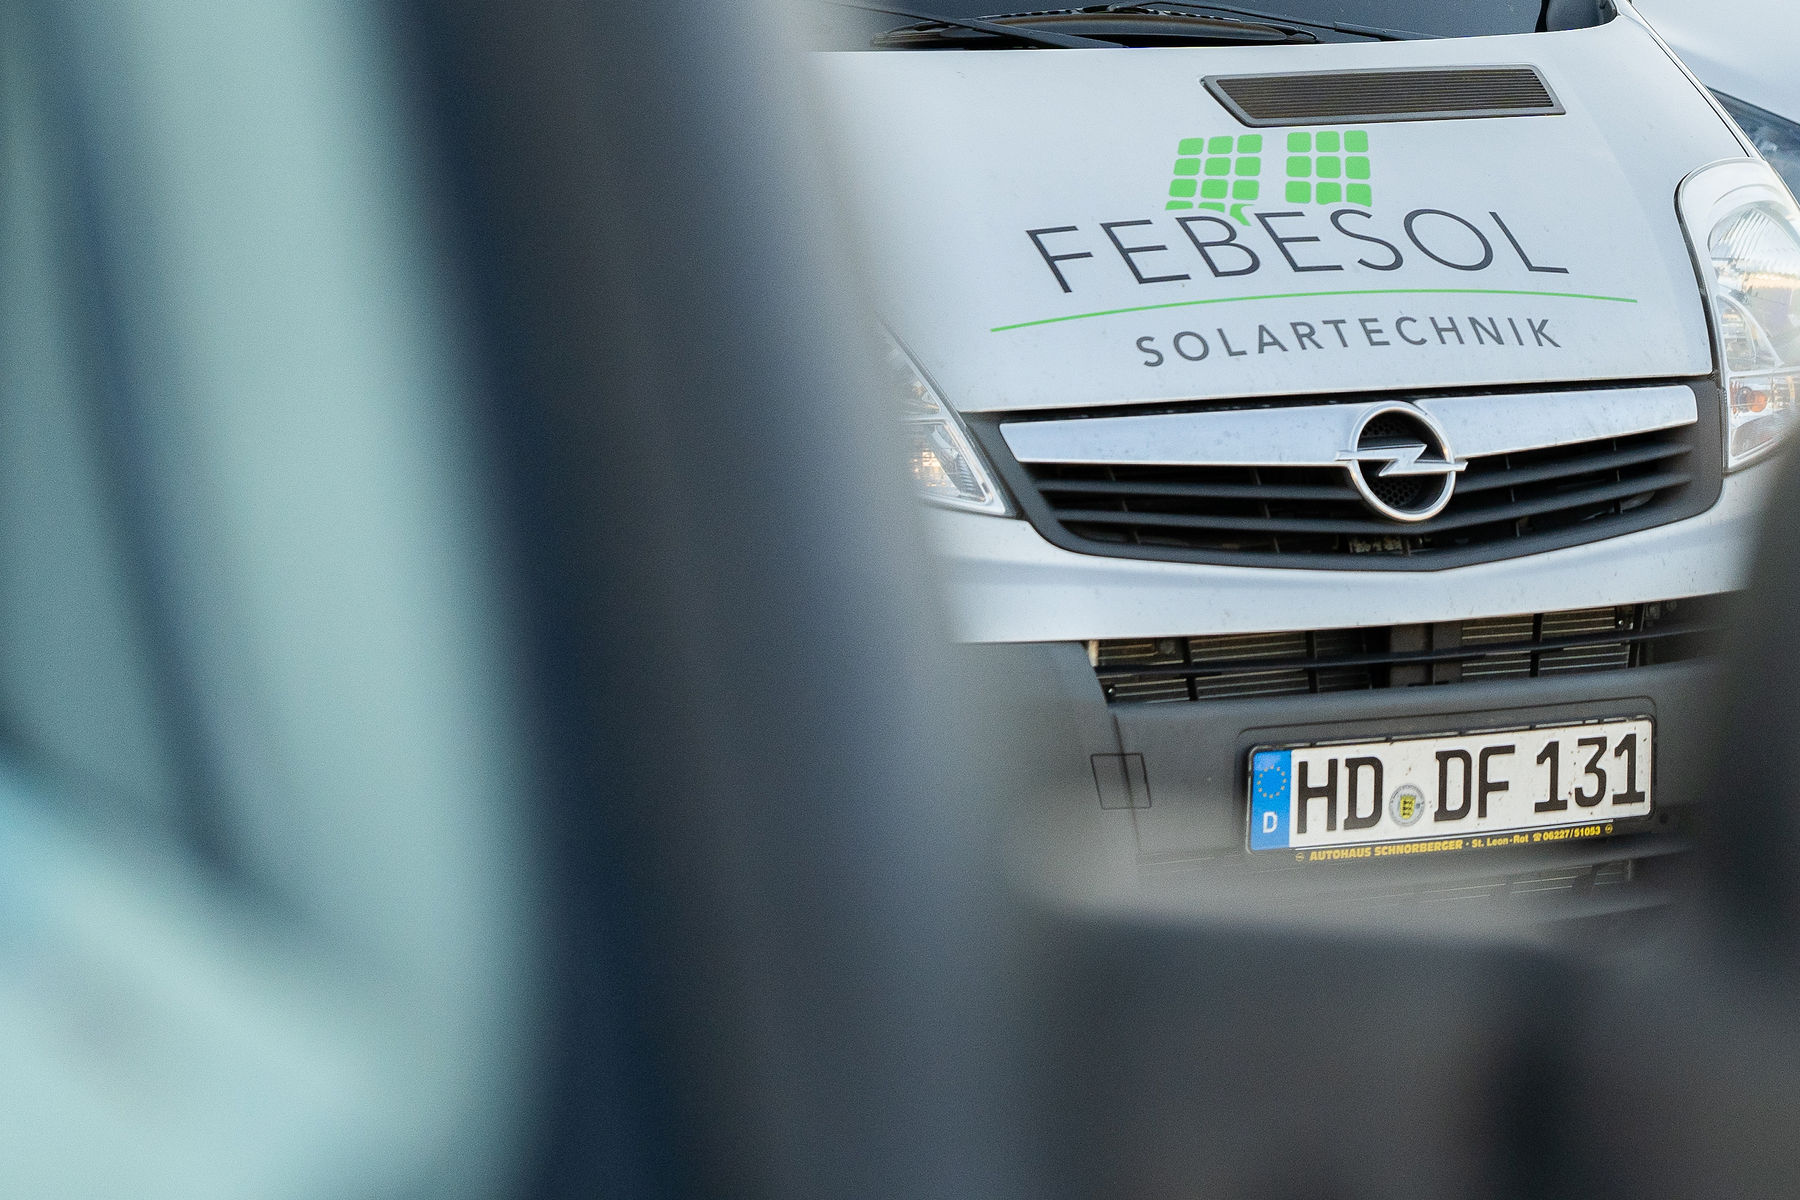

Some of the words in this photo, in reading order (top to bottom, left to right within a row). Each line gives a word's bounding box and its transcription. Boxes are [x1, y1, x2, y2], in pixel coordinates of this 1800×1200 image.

[1026, 208, 1570, 294] FEBESOL
[1136, 315, 1562, 368] SOLARTECHNIK
[1297, 757, 1384, 834] HD
[1434, 745, 1515, 822] DF
[1535, 734, 1646, 813] 131
[1263, 812, 1277, 833] D
[1309, 847, 1371, 862] AUTOHAUS
[1374, 839, 1463, 856] SCHNORBERGER
